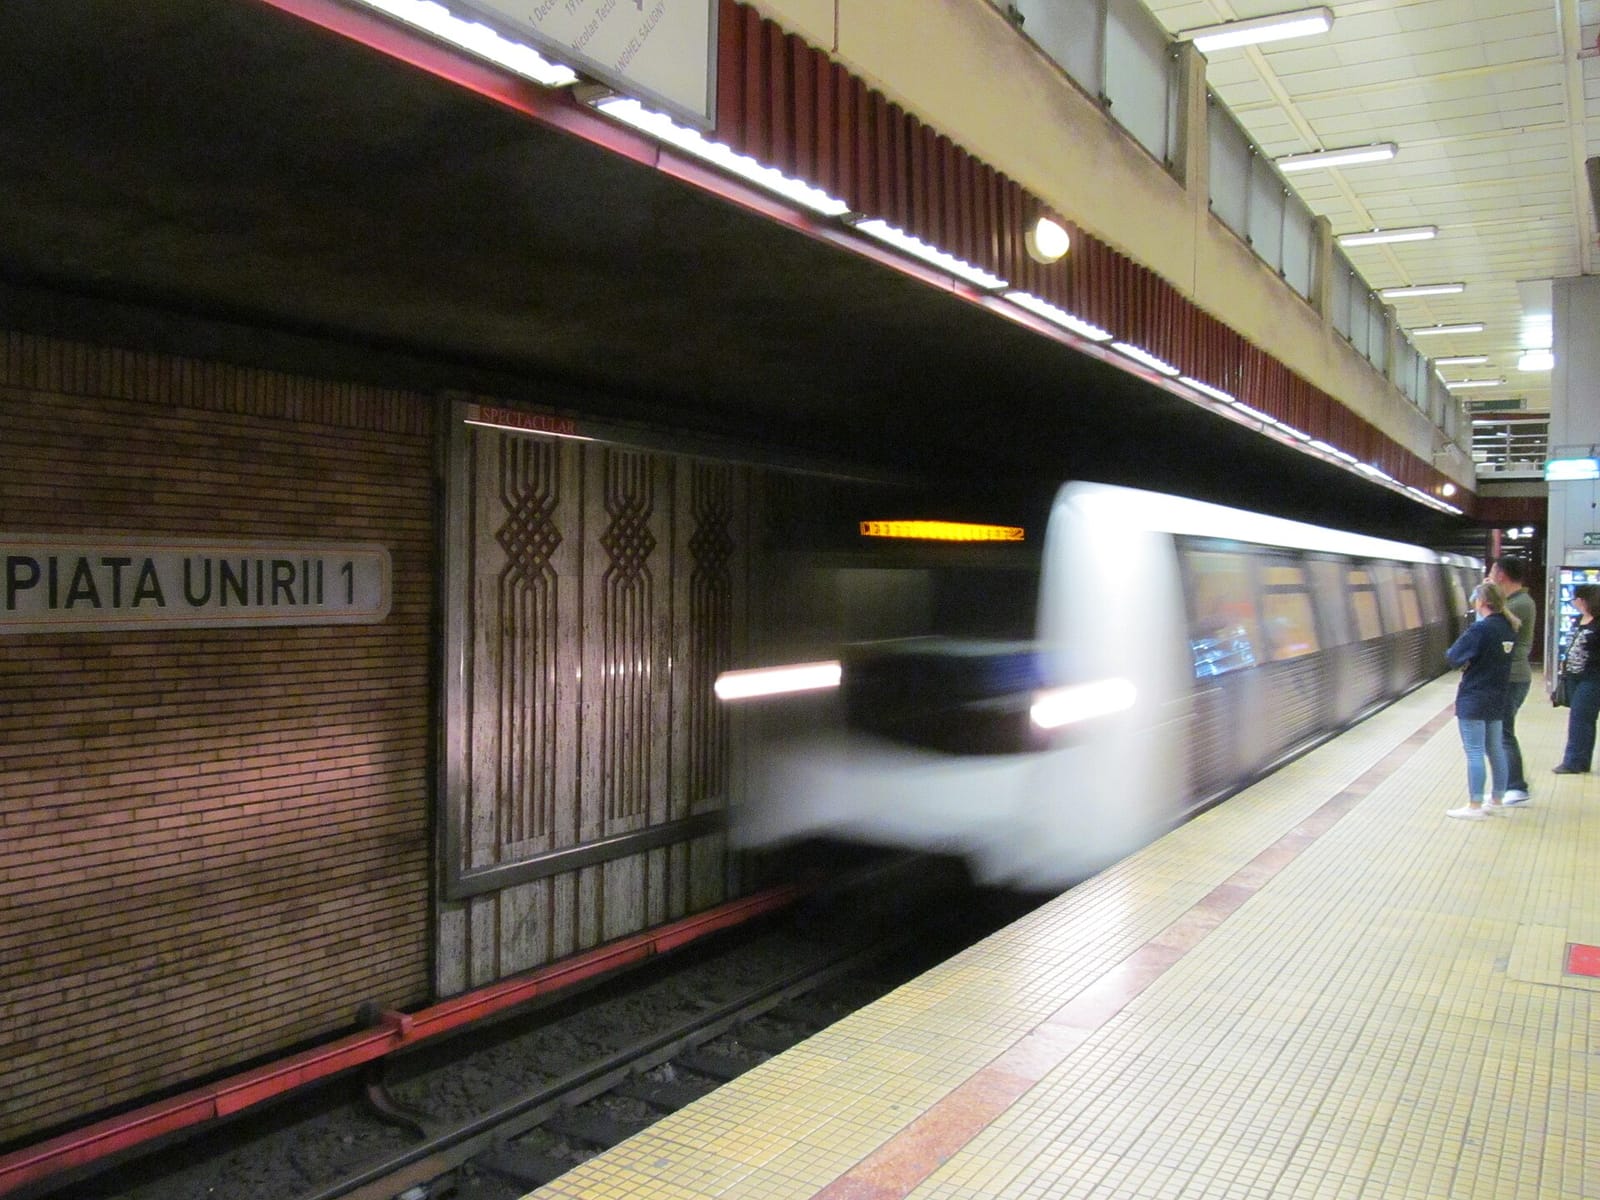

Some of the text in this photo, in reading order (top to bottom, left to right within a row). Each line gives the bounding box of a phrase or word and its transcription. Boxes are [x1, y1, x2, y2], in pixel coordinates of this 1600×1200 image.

[614, 1, 666, 74] ANGHEL SALIGNY
[483, 407, 576, 433] SPECTACULAR
[6, 555, 354, 610] PIATA UNIRII 1
